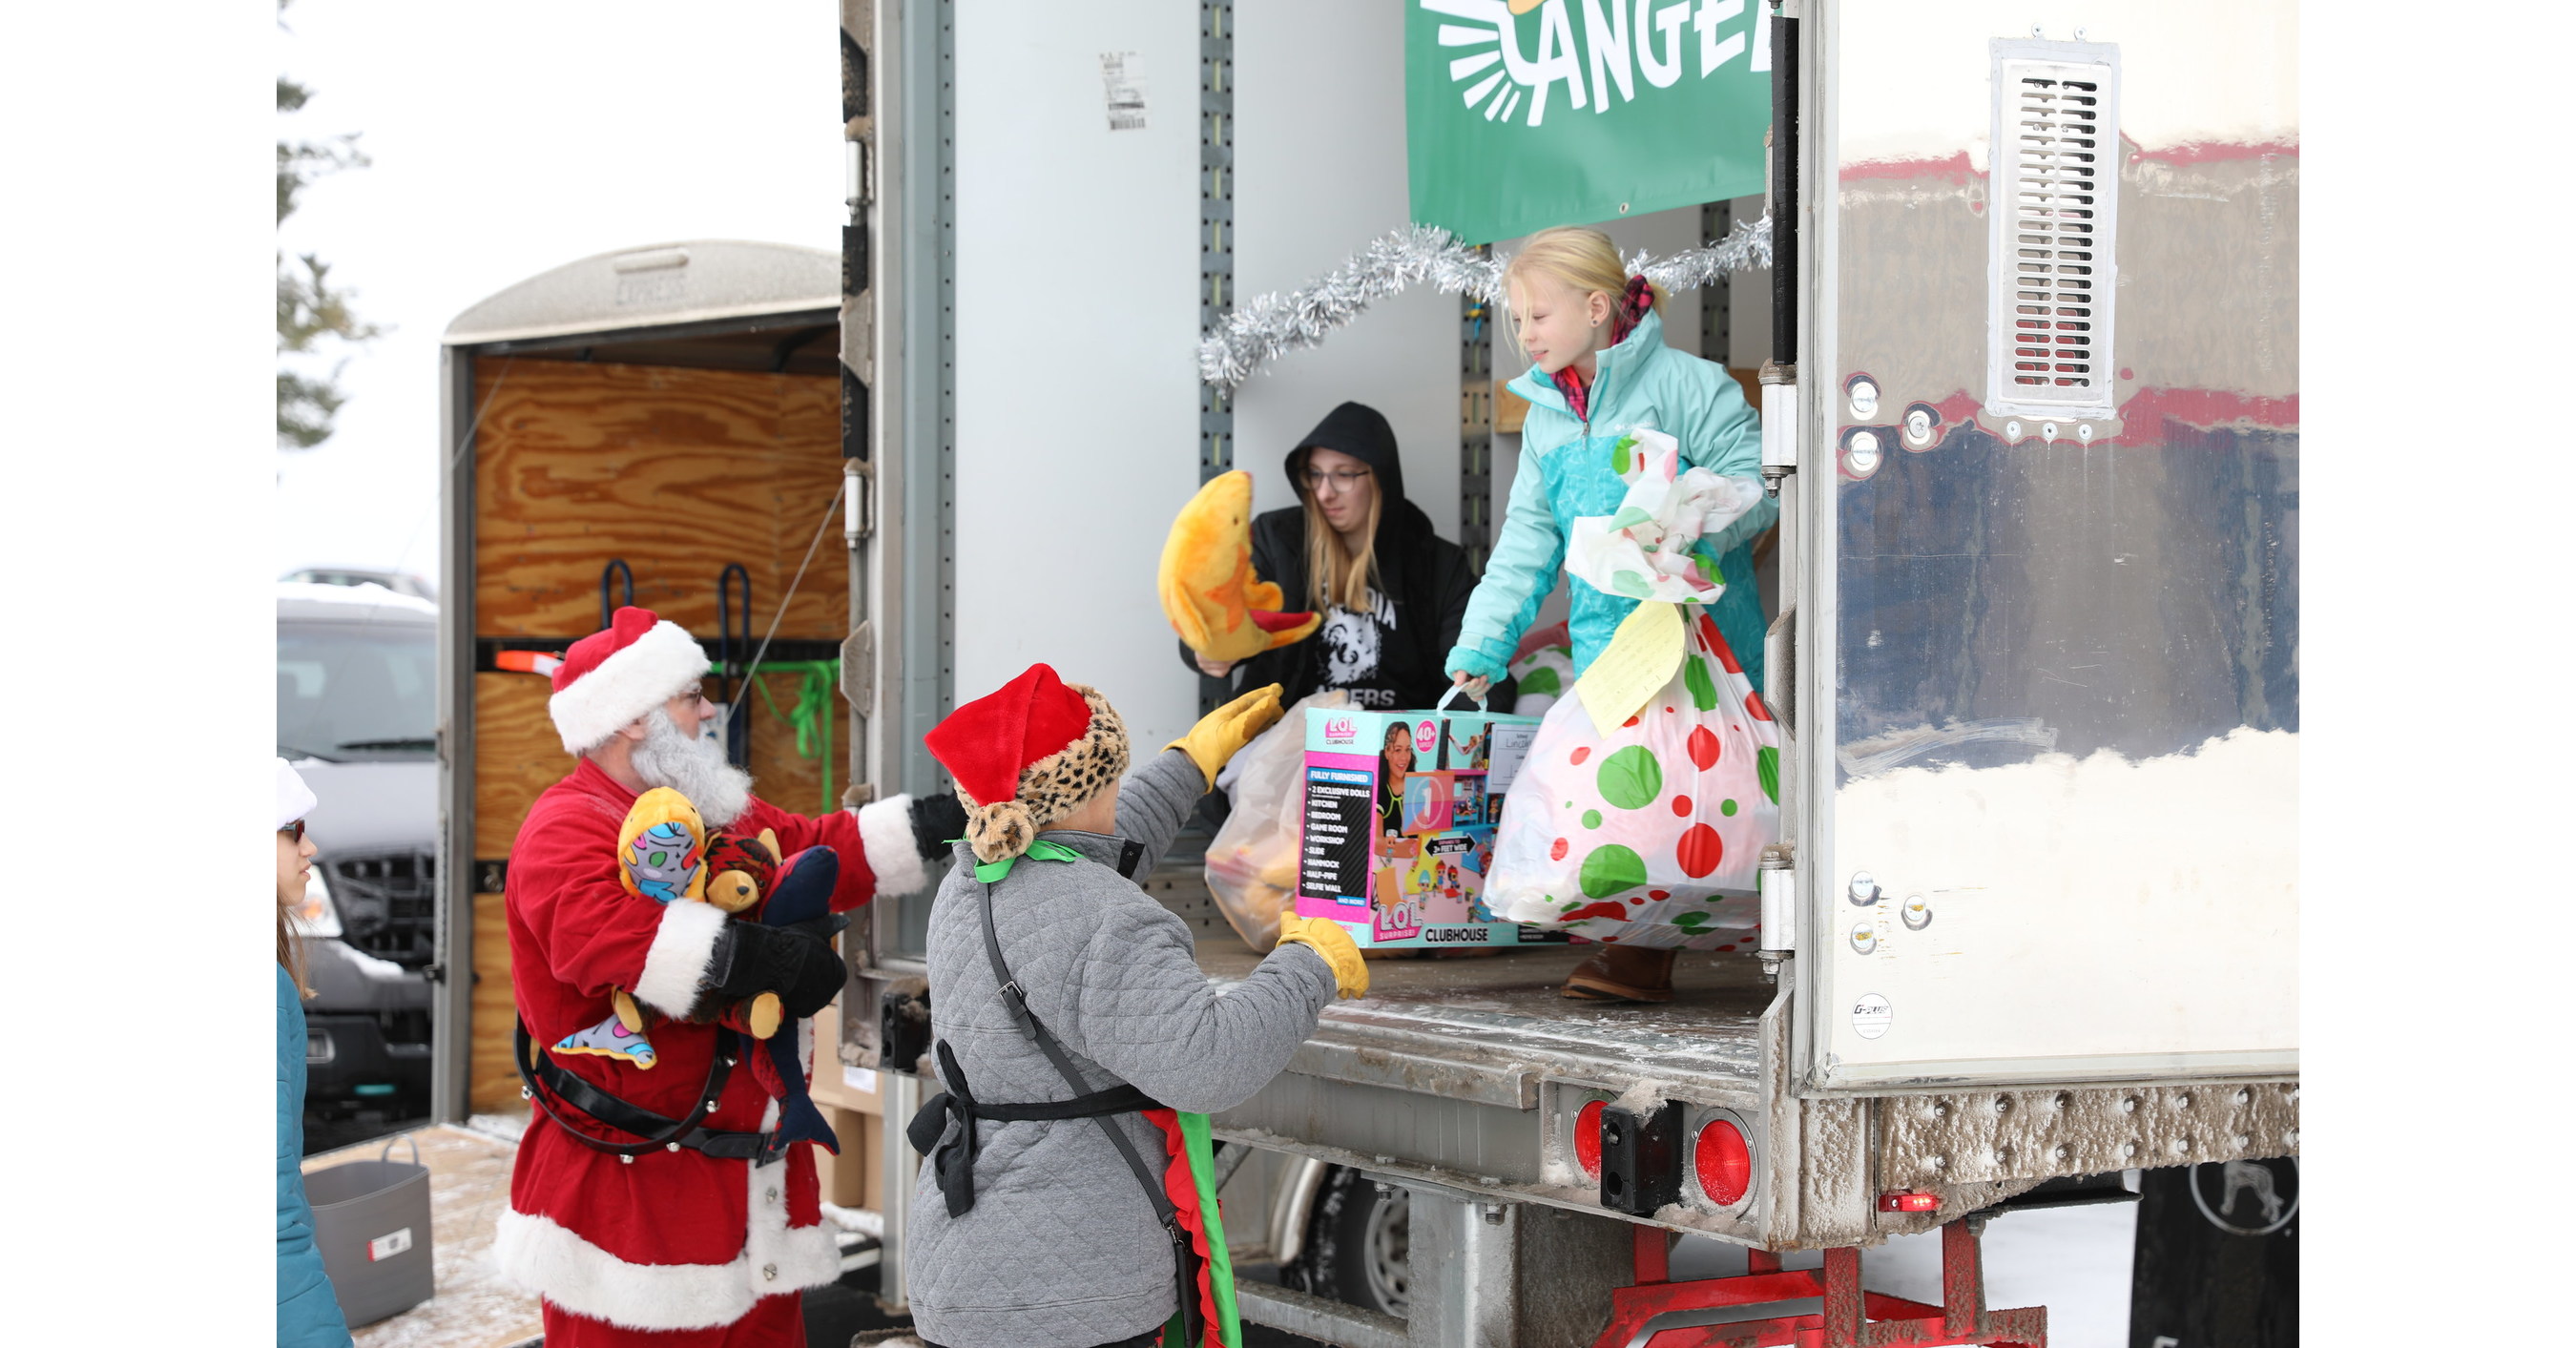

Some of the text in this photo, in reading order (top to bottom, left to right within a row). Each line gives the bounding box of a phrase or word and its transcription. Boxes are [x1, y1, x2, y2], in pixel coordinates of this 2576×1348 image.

[1329, 717, 1358, 733] LOL
[1416, 727, 1435, 741] 40+
[1310, 770, 1368, 783] FULLY FURNISHED
[1317, 786, 1349, 797] EXCLUSIVE
[1350, 789, 1370, 798] DOLLS
[1311, 799, 1338, 809] KITCHEN
[1311, 811, 1341, 820] BEDROOM
[1310, 822, 1348, 834] GAME ROOM
[1310, 835, 1345, 845] WORKSHOP
[1308, 846, 1325, 856] SLIDE
[1307, 859, 1340, 869] HAMMOCK
[1306, 870, 1338, 881] HALF-PIPE
[1305, 881, 1342, 893] SELFIE WALL
[1380, 901, 1423, 931] LOL
[1379, 929, 1415, 940] SURPRISE!
[1425, 928, 1488, 943] CLUBHOUSE
